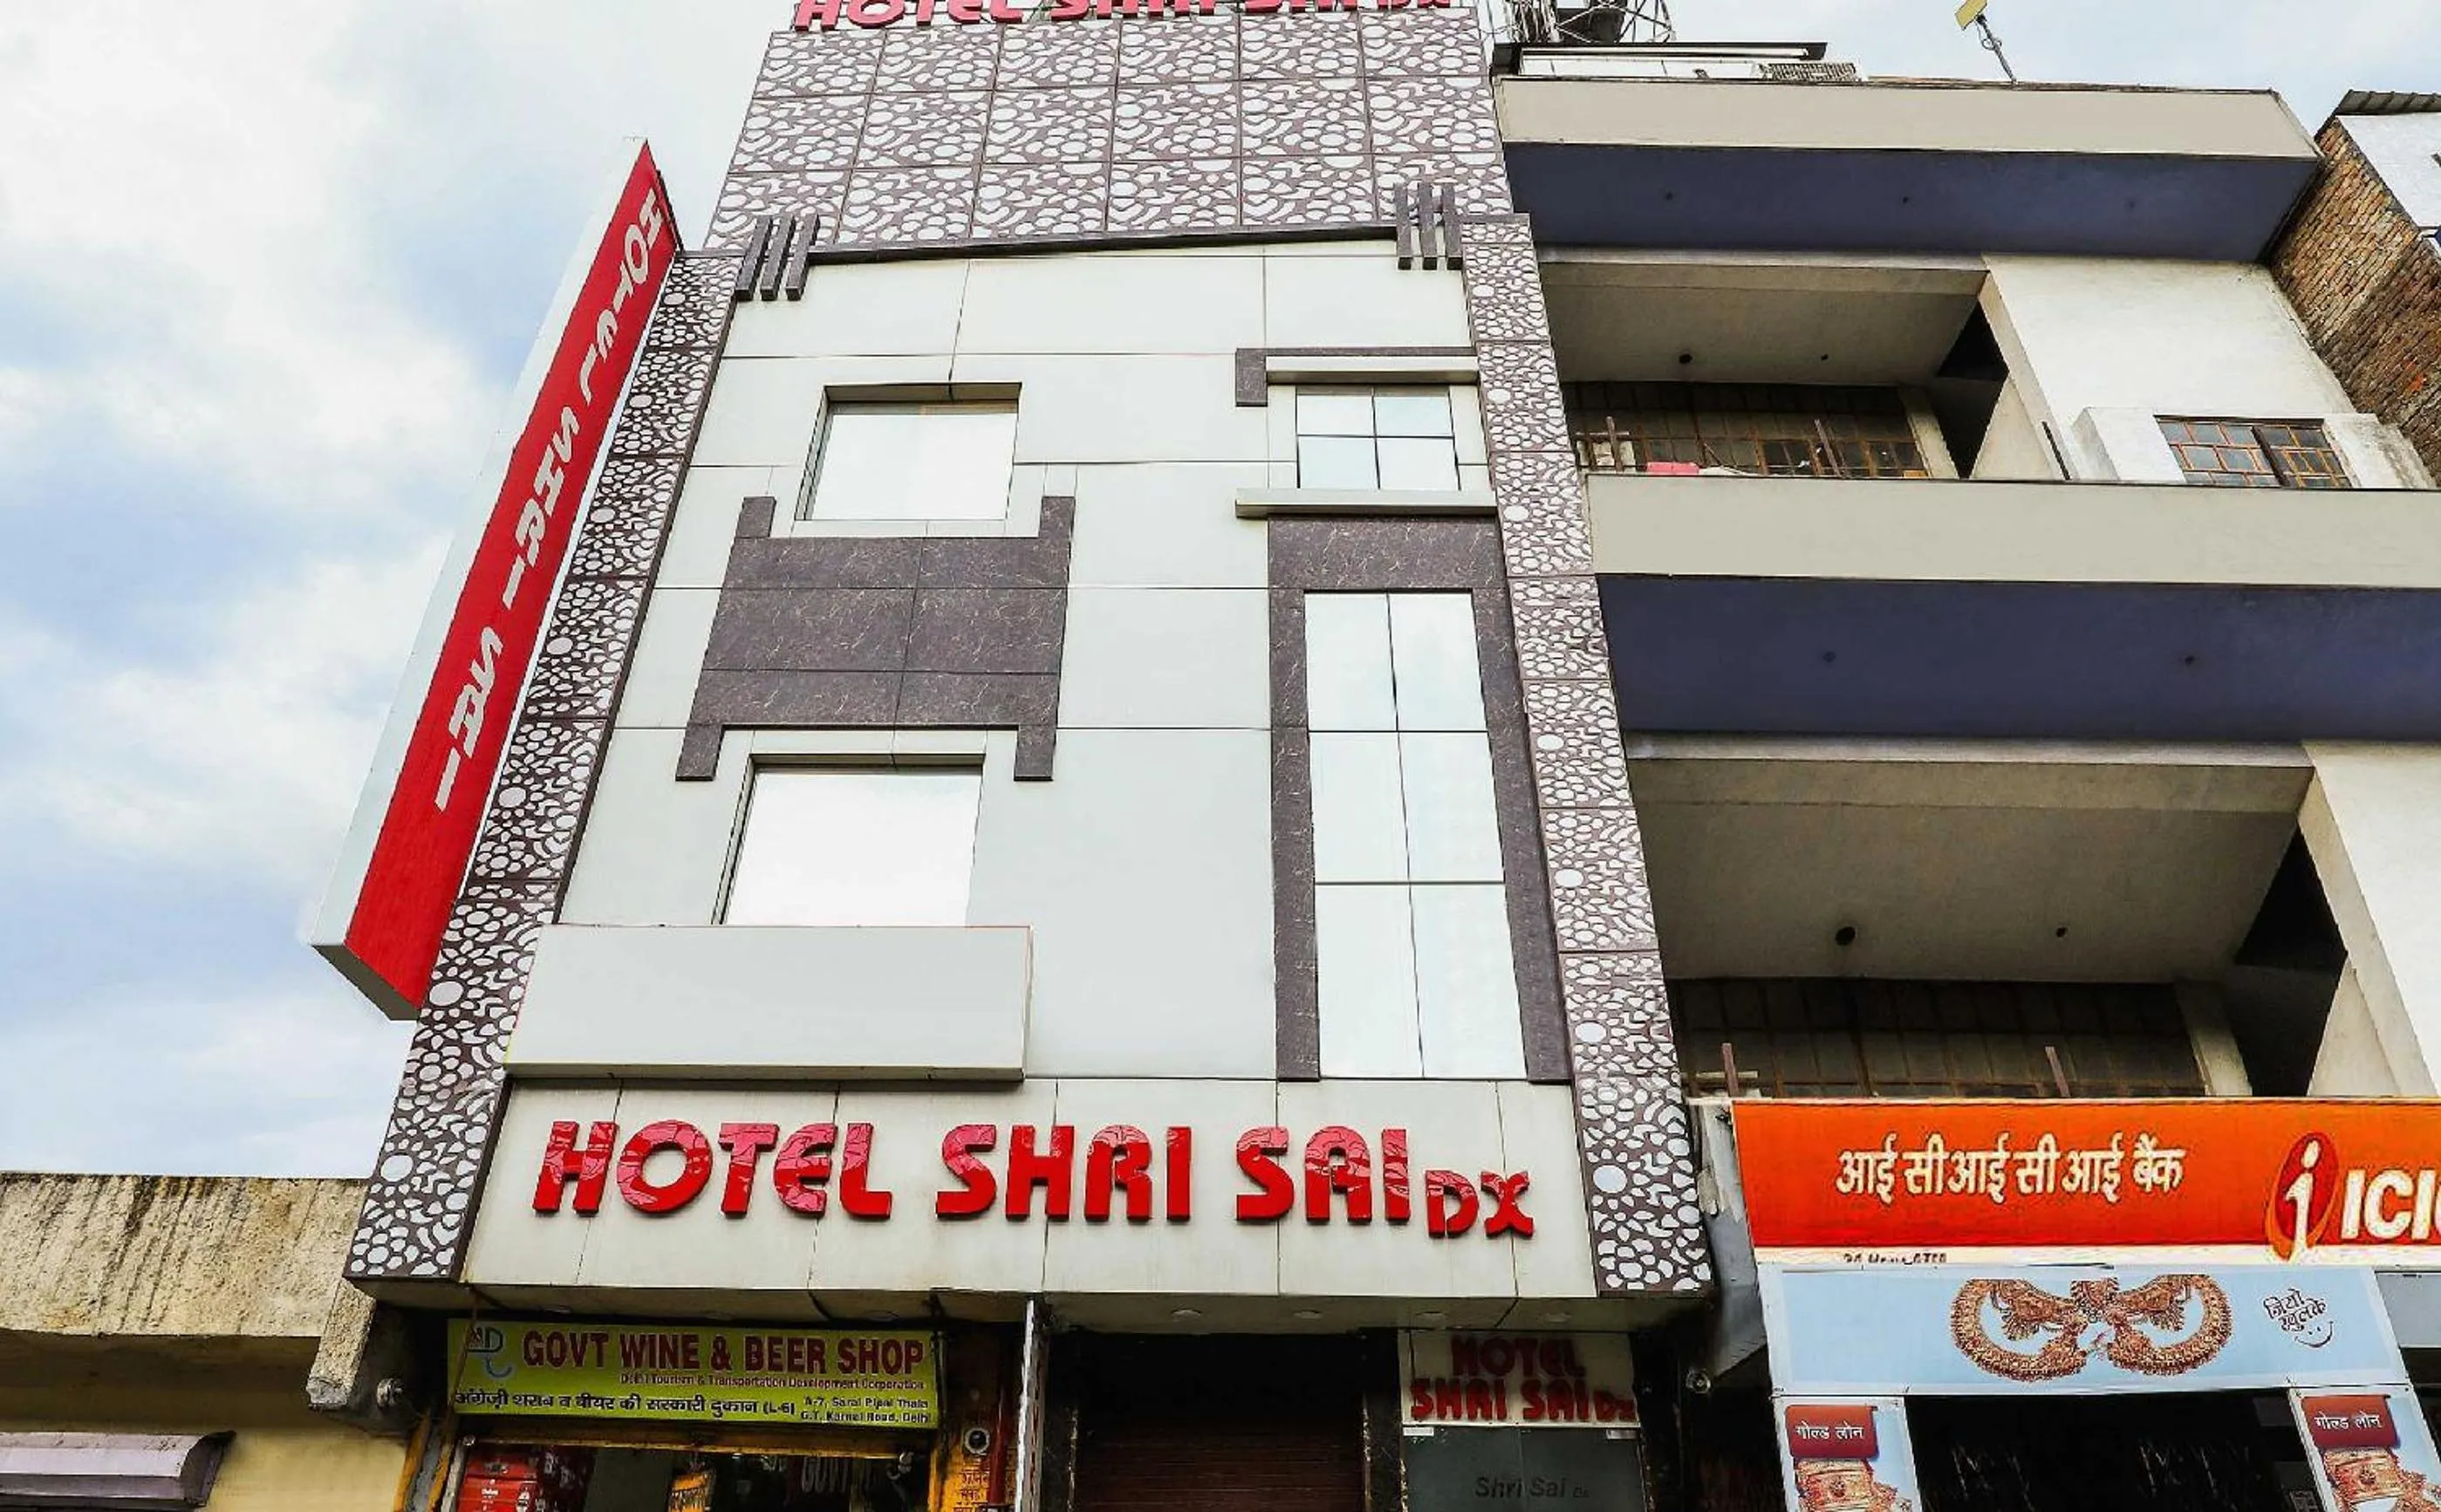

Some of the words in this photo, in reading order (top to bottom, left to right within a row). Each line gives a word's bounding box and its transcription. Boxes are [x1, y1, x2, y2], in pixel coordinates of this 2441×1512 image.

[578, 187, 664, 406] HOTEL
[502, 406, 580, 610] SHRI
[434, 626, 504, 812] SAI
[532, 1120, 892, 1219] HOTEL
[935, 1124, 1193, 1221] SHRI
[1235, 1125, 1412, 1224] SAI
[2131, 1133, 2186, 1193] बैंक
[2341, 1166, 2441, 1242] ICI
[523, 1330, 609, 1368] GOVT
[619, 1333, 701, 1371] WINE
[711, 1334, 732, 1372] &
[743, 1336, 827, 1375] BEER
[837, 1338, 925, 1376] SHOP
[1450, 1334, 1587, 1378] HOTEL
[619, 1393, 641, 1411] की
[646, 1394, 706, 1413] सरकारी
[710, 1399, 758, 1419] दुकान
[1410, 1378, 1508, 1421] SHRI
[1521, 1379, 1590, 1422] SAI
[2314, 1410, 2349, 1430] गोल्ड
[1795, 1420, 1830, 1440] गोल्ड
[1835, 1420, 1864, 1440] लोन
[1474, 1476, 1522, 1499] Shri
[1528, 1476, 1568, 1499] Sai
